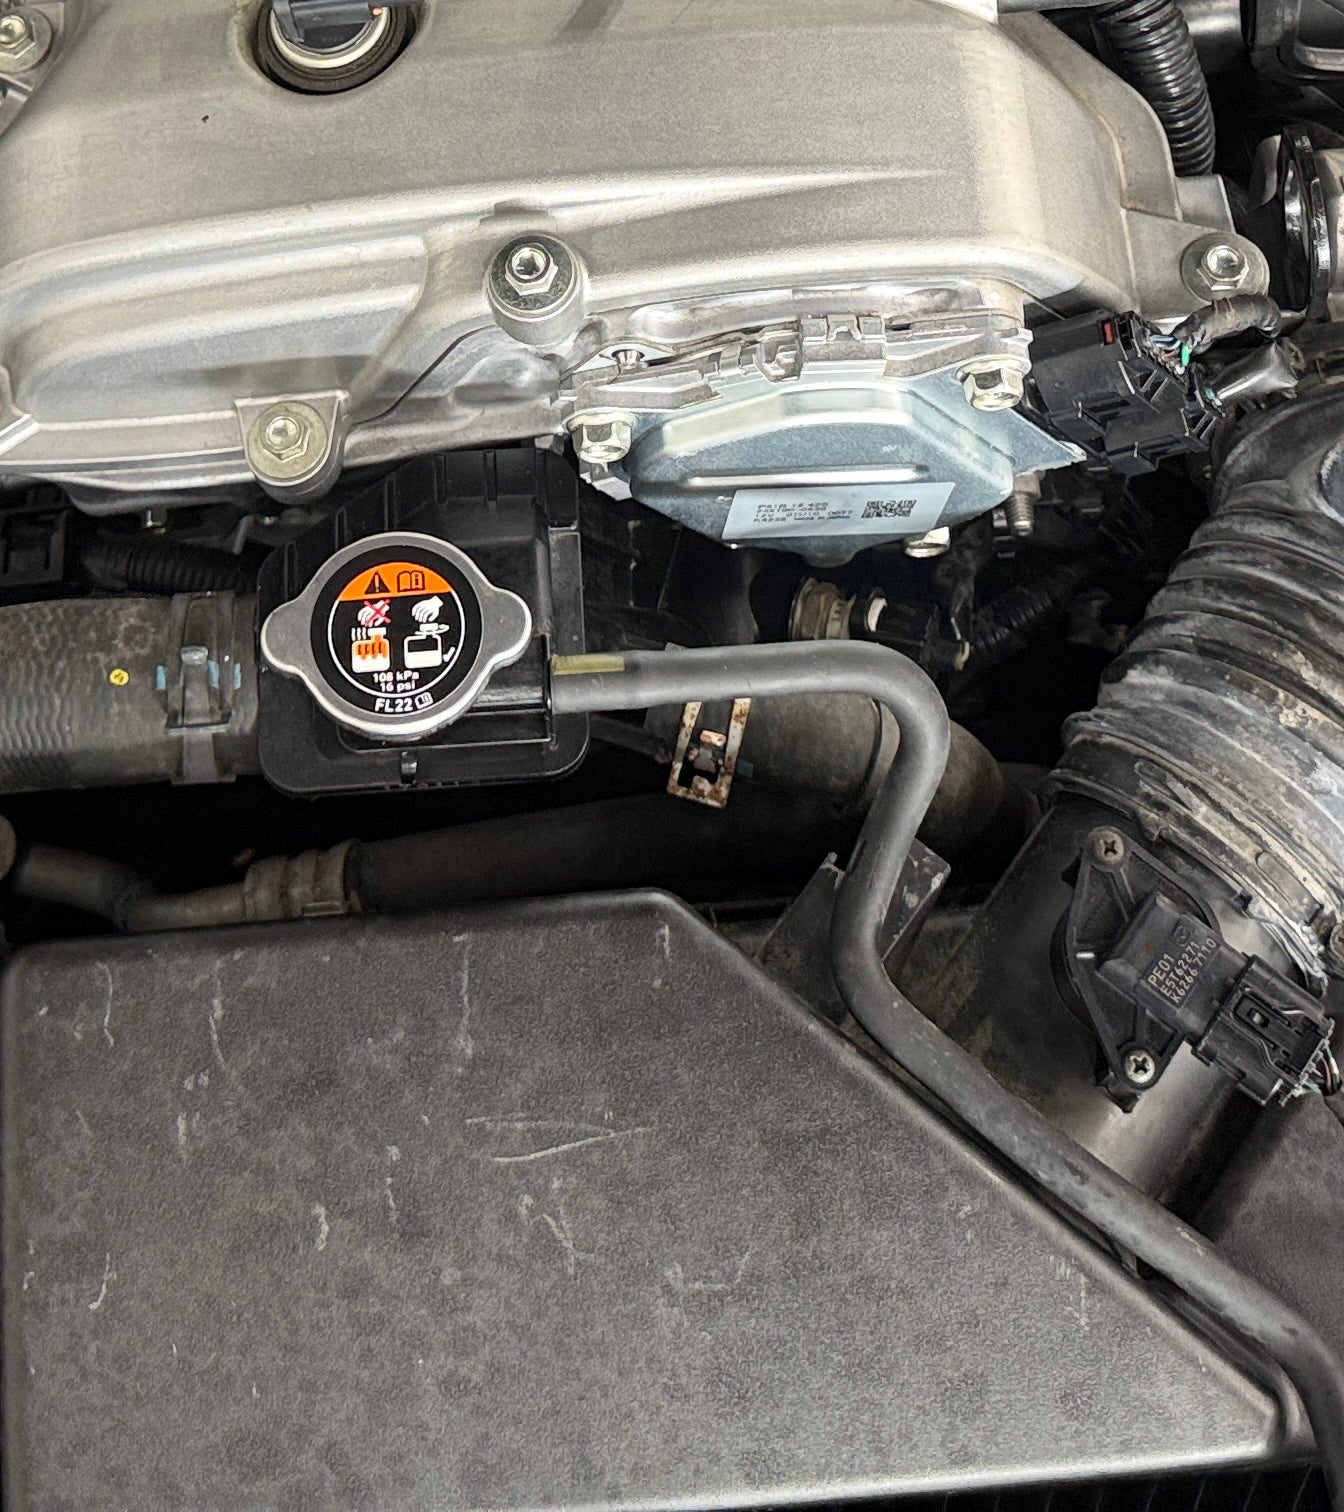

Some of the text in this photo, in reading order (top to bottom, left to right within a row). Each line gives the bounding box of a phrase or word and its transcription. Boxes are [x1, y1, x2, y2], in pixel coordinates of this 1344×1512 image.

[373, 670, 420, 684] 108 kPa
[380, 680, 416, 693] 16 psi
[374, 696, 413, 712] FL22
[1192, 937, 1217, 966] 7110
[1147, 953, 1174, 986] PE01
[1158, 941, 1199, 996] E5T62271
